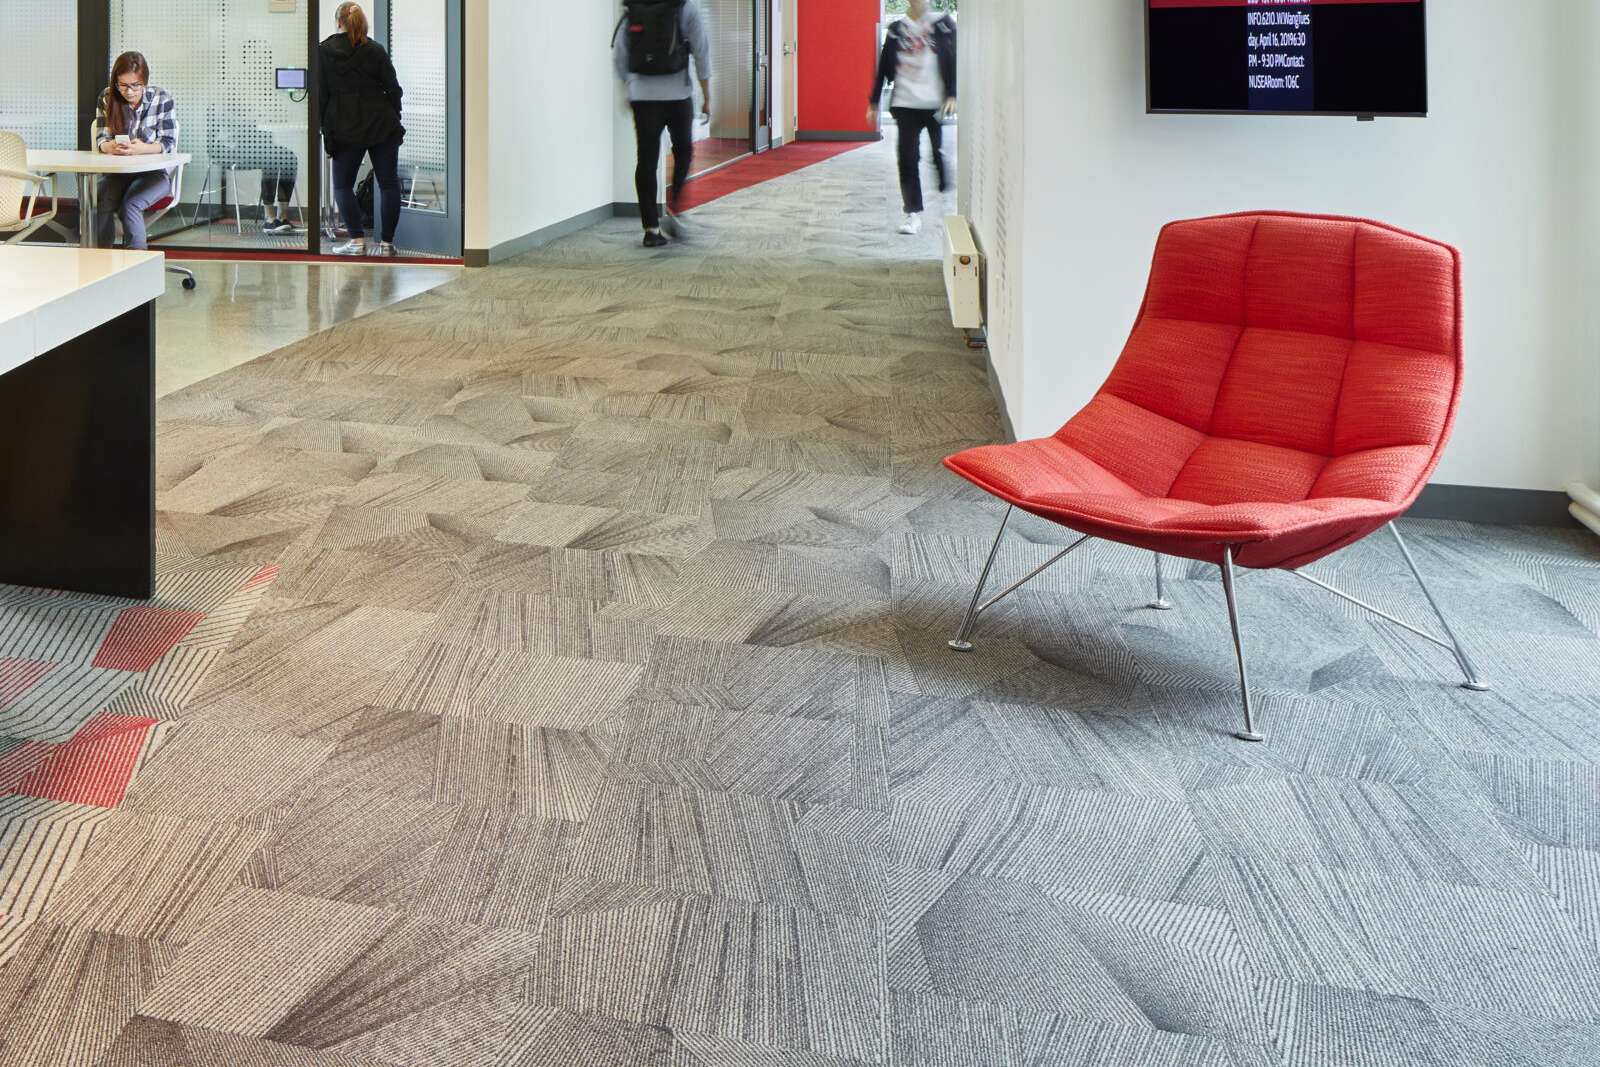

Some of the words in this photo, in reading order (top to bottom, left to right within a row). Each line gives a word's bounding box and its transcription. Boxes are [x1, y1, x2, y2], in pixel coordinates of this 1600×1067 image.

[1259, 32, 1272, 51] April
[1272, 32, 1280, 48] 16,
[1248, 54, 1258, 67] PM
[1261, 53, 1275, 68] 9:30
[1284, 74, 1300, 89] 106C
